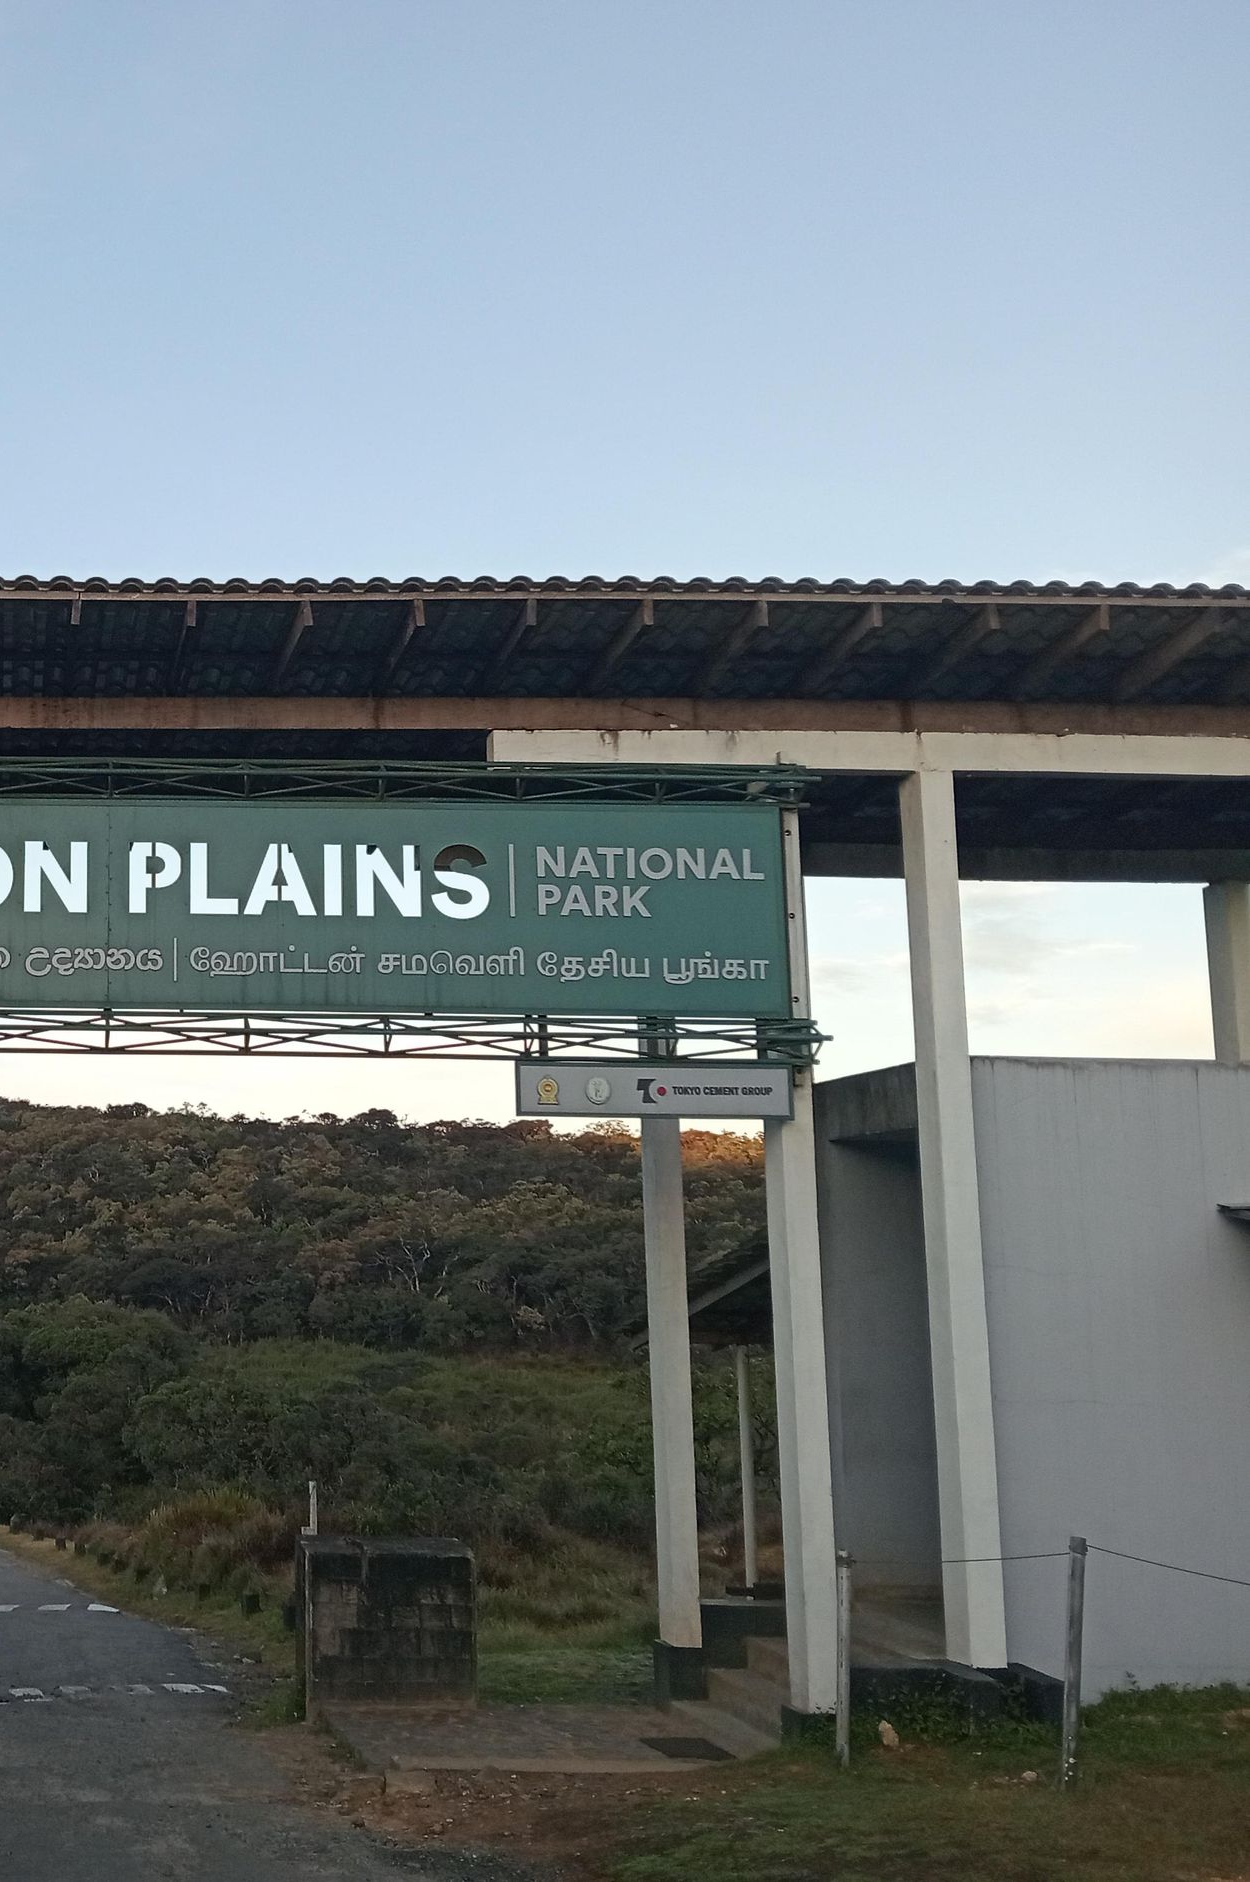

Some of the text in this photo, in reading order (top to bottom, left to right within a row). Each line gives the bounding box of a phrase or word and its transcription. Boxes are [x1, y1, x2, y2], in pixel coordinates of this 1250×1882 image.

[536, 846, 765, 880] NATIONAL
[129, 842, 490, 919] PLAINS
[537, 884, 652, 917] PARK
[189, 944, 770, 985] ஹோட்டன் சமவெளி தேசிய பூங்கா
[672, 1086, 773, 1096] TOKYO CEMENT GROUP
